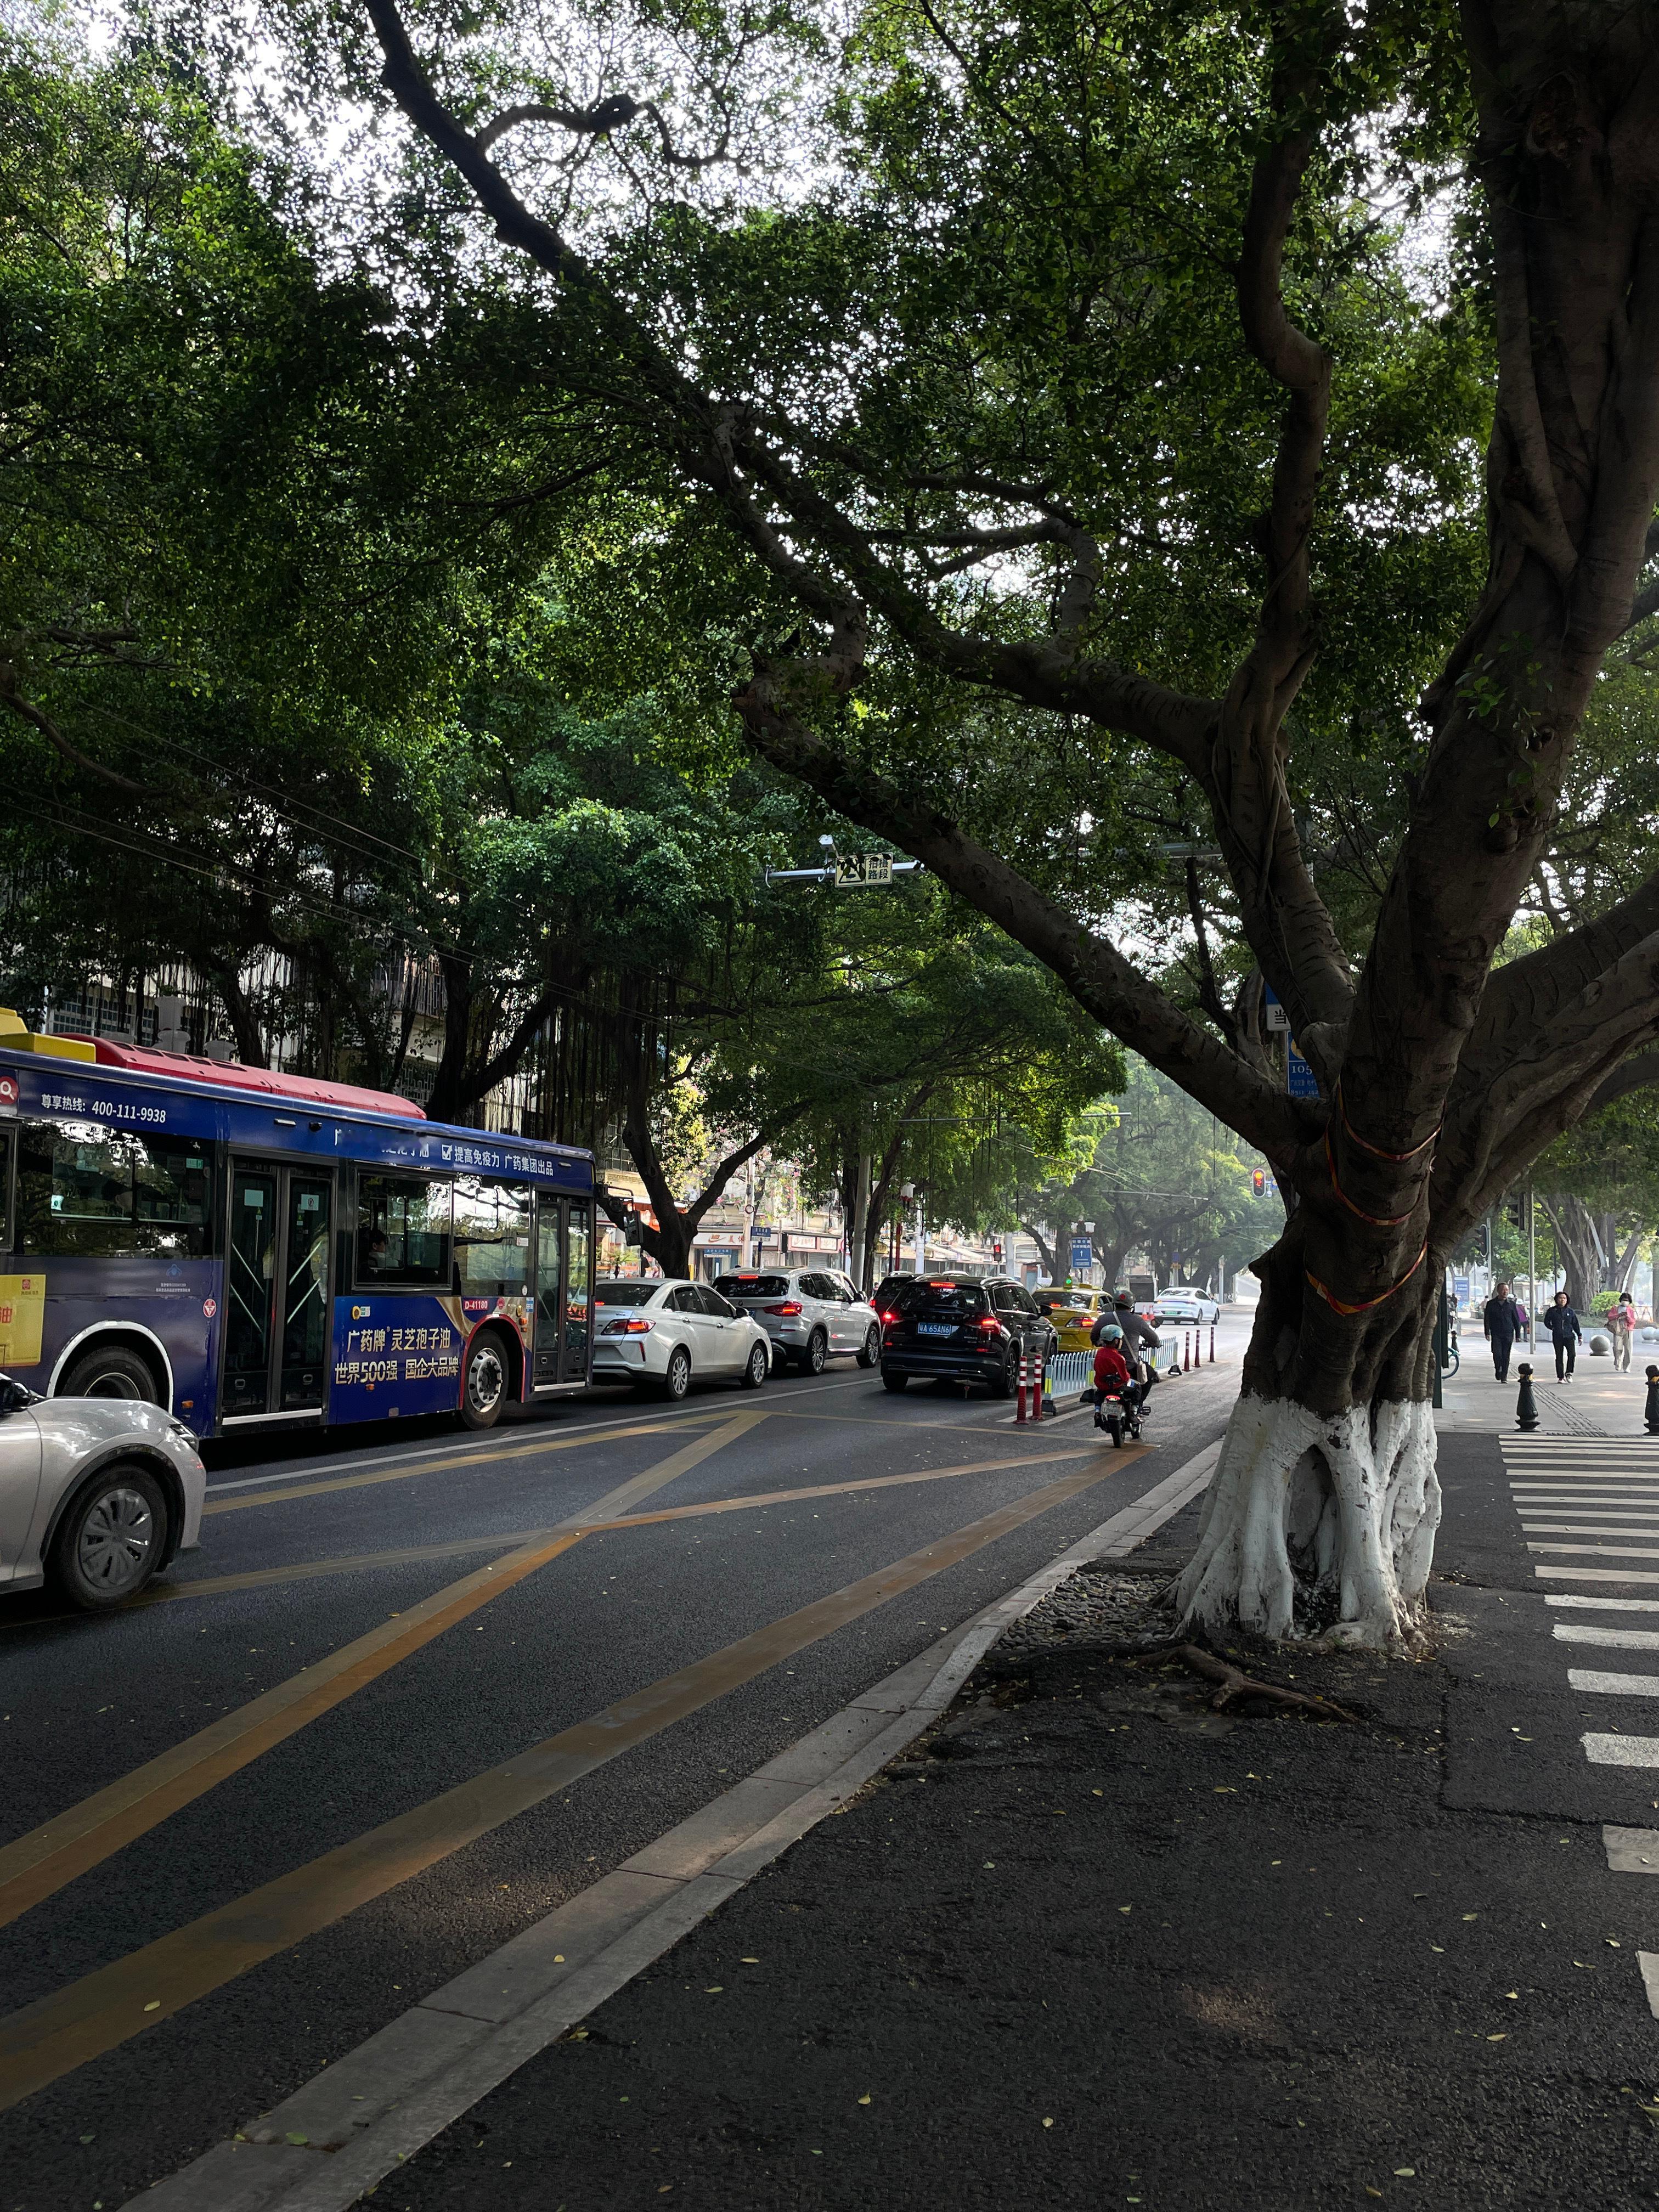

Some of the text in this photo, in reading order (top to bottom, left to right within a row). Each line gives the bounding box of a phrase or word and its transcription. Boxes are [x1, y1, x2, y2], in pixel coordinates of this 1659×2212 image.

[868, 869, 888, 879] 路段
[92, 1101, 166, 1123] 400-111-9938
[454, 1146, 554, 1176] 提高免疫力 广药集团出品
[465, 1300, 488, 1310] D-41180
[391, 1327, 451, 1351] 灵芝孢子油
[335, 1356, 459, 1385] 世界500强 国企大品牌
